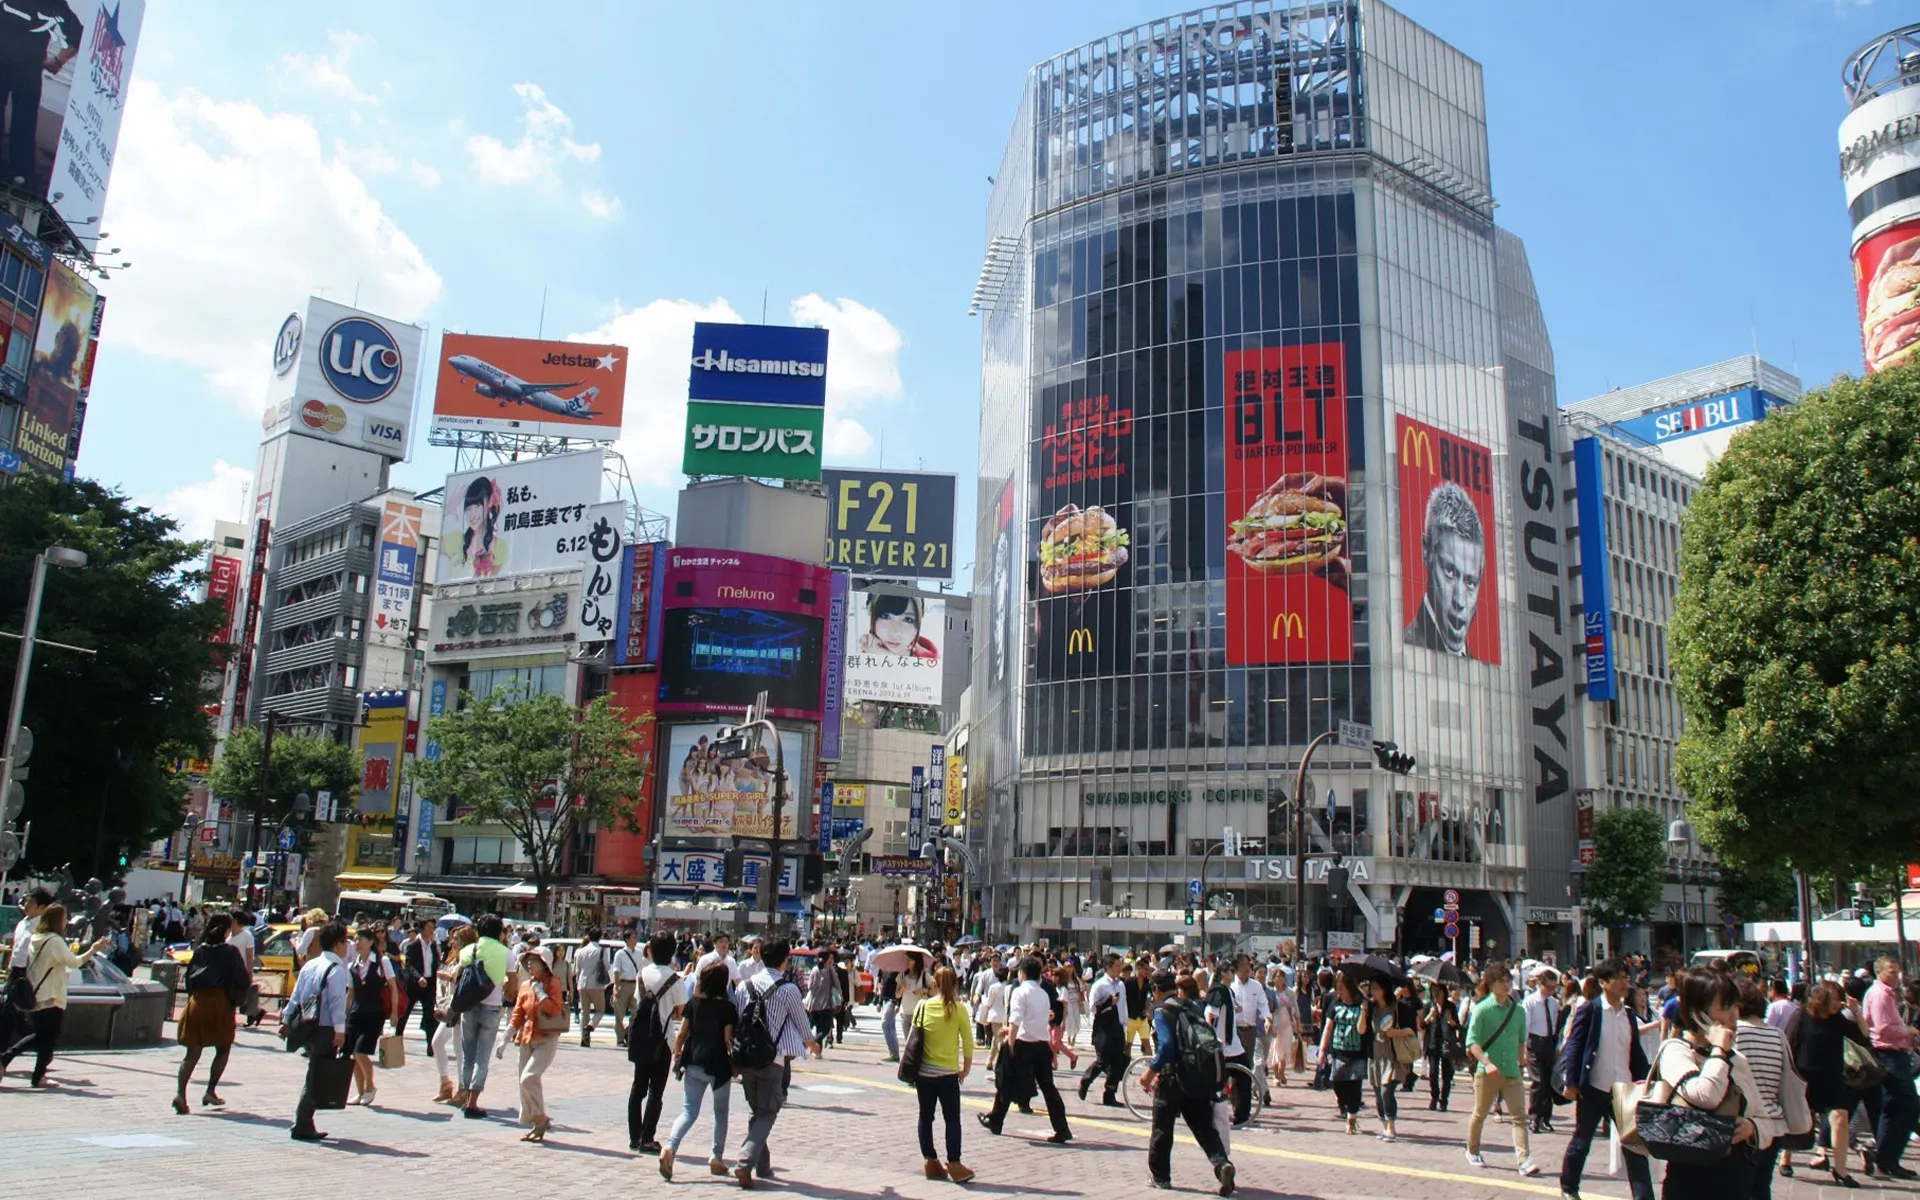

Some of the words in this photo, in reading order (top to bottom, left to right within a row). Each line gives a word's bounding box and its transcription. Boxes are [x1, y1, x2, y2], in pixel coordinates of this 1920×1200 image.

[542, 352, 599, 369] Jetstar
[692, 349, 825, 377] Hisamitsu
[303, 406, 346, 426] MasterCard
[1234, 388, 1336, 446] BLT
[1655, 396, 1741, 441] SEIBU
[20, 410, 69, 453] Linked
[370, 423, 403, 442] VISA
[692, 423, 816, 456] サロンパス
[18, 429, 64, 471] Horizon
[1440, 436, 1491, 495] BITE!
[506, 484, 539, 505] 私も、
[837, 479, 918, 534] F21
[382, 504, 421, 546] 本
[503, 503, 587, 533] 前島亜美です
[710, 558, 741, 566] チャンネル
[923, 543, 948, 569] 21
[378, 583, 411, 600] 夜11時
[581, 516, 622, 638] もんじゃ
[382, 599, 404, 612] まで
[717, 585, 775, 601] Melumo
[389, 616, 409, 632] 地下
[1518, 415, 1569, 805] TSUTAYA
[1585, 610, 1607, 683] SEIBU
[907, 683, 932, 694] Album
[930, 748, 945, 820] 洋服の青山
[1085, 788, 1192, 807] STARBUCKS
[1202, 787, 1276, 803] COFFEE
[909, 775, 923, 851] 洋服の青山
[1430, 800, 1502, 826] TSUTAYA
